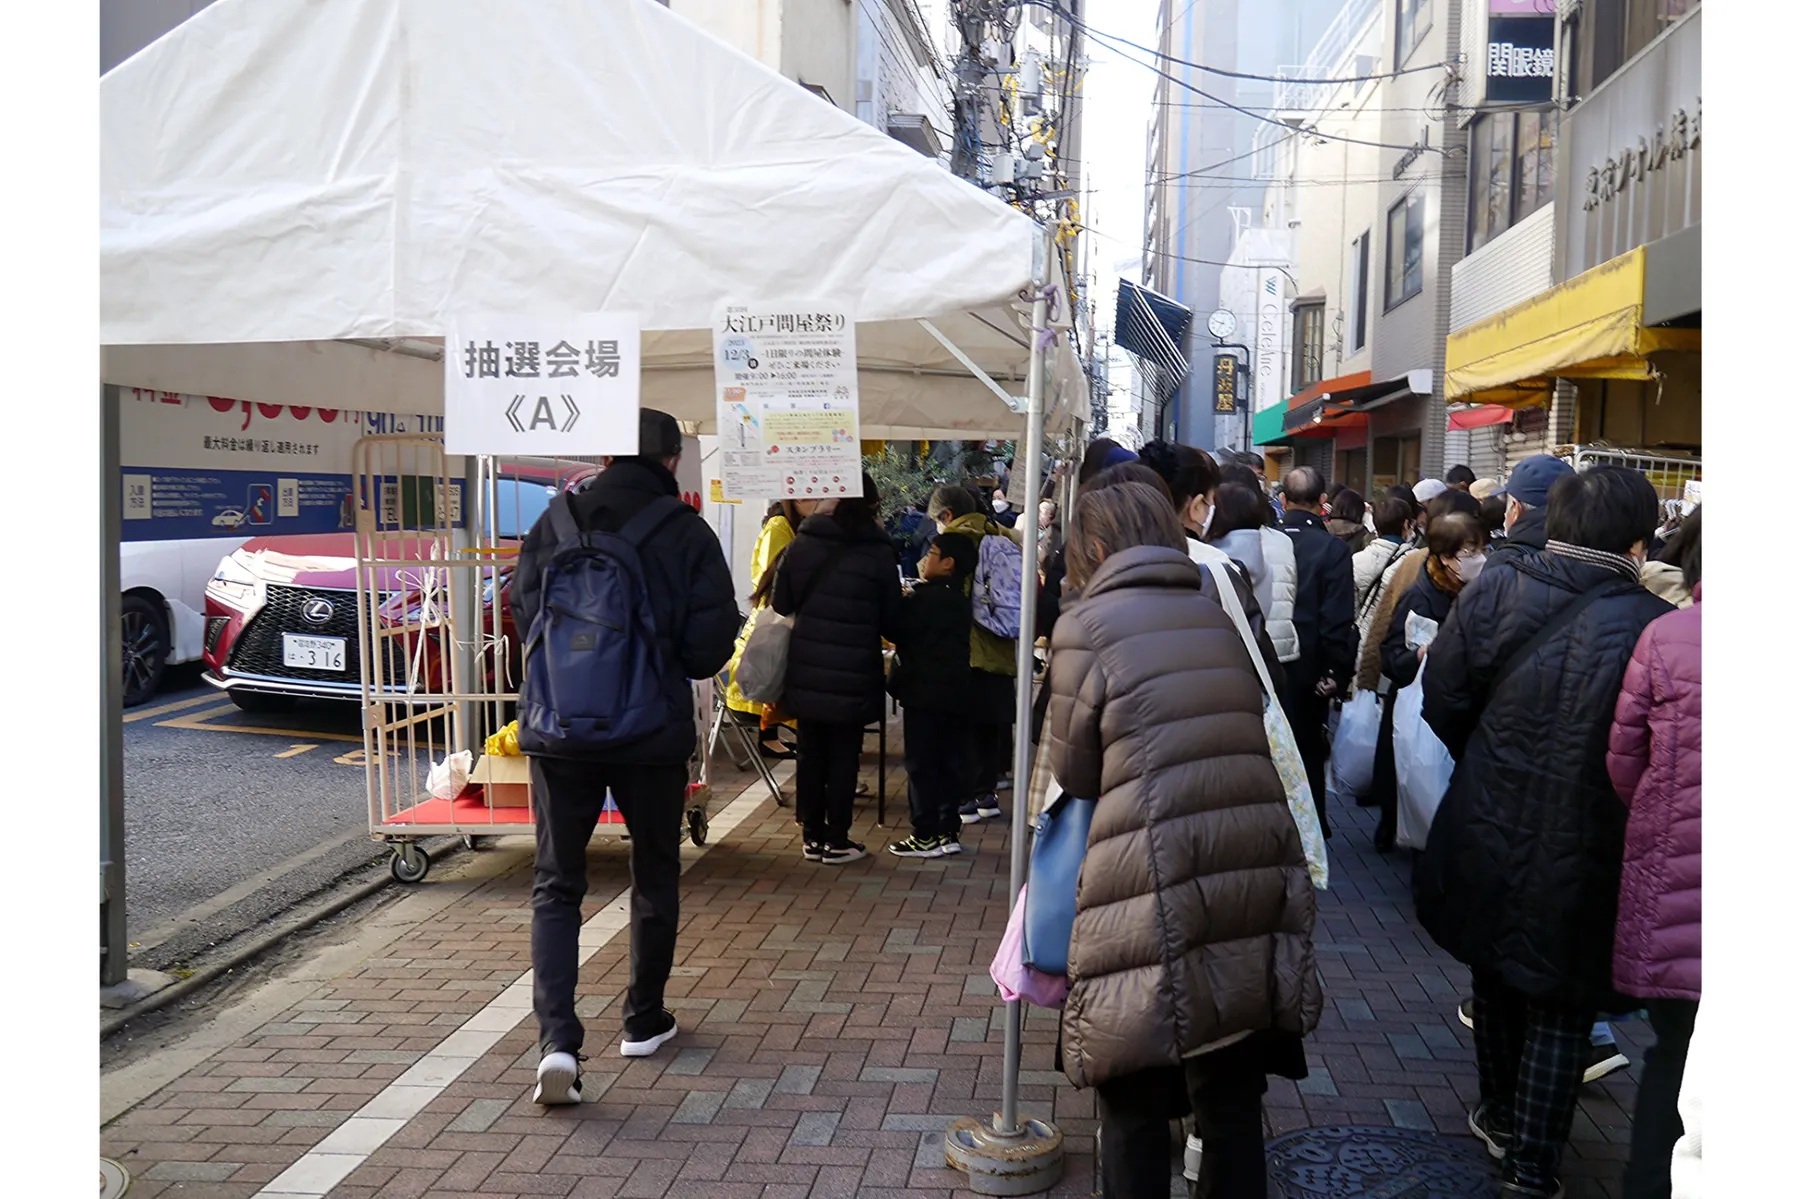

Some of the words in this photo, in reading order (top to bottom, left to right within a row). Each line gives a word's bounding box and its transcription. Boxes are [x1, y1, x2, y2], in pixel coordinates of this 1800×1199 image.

[720, 313, 846, 334] 大江戸問屋祭り
[464, 340, 621, 379] 抽選会場
[723, 348, 751, 361] 12/3
[786, 445, 842, 454] スタンプラリー
